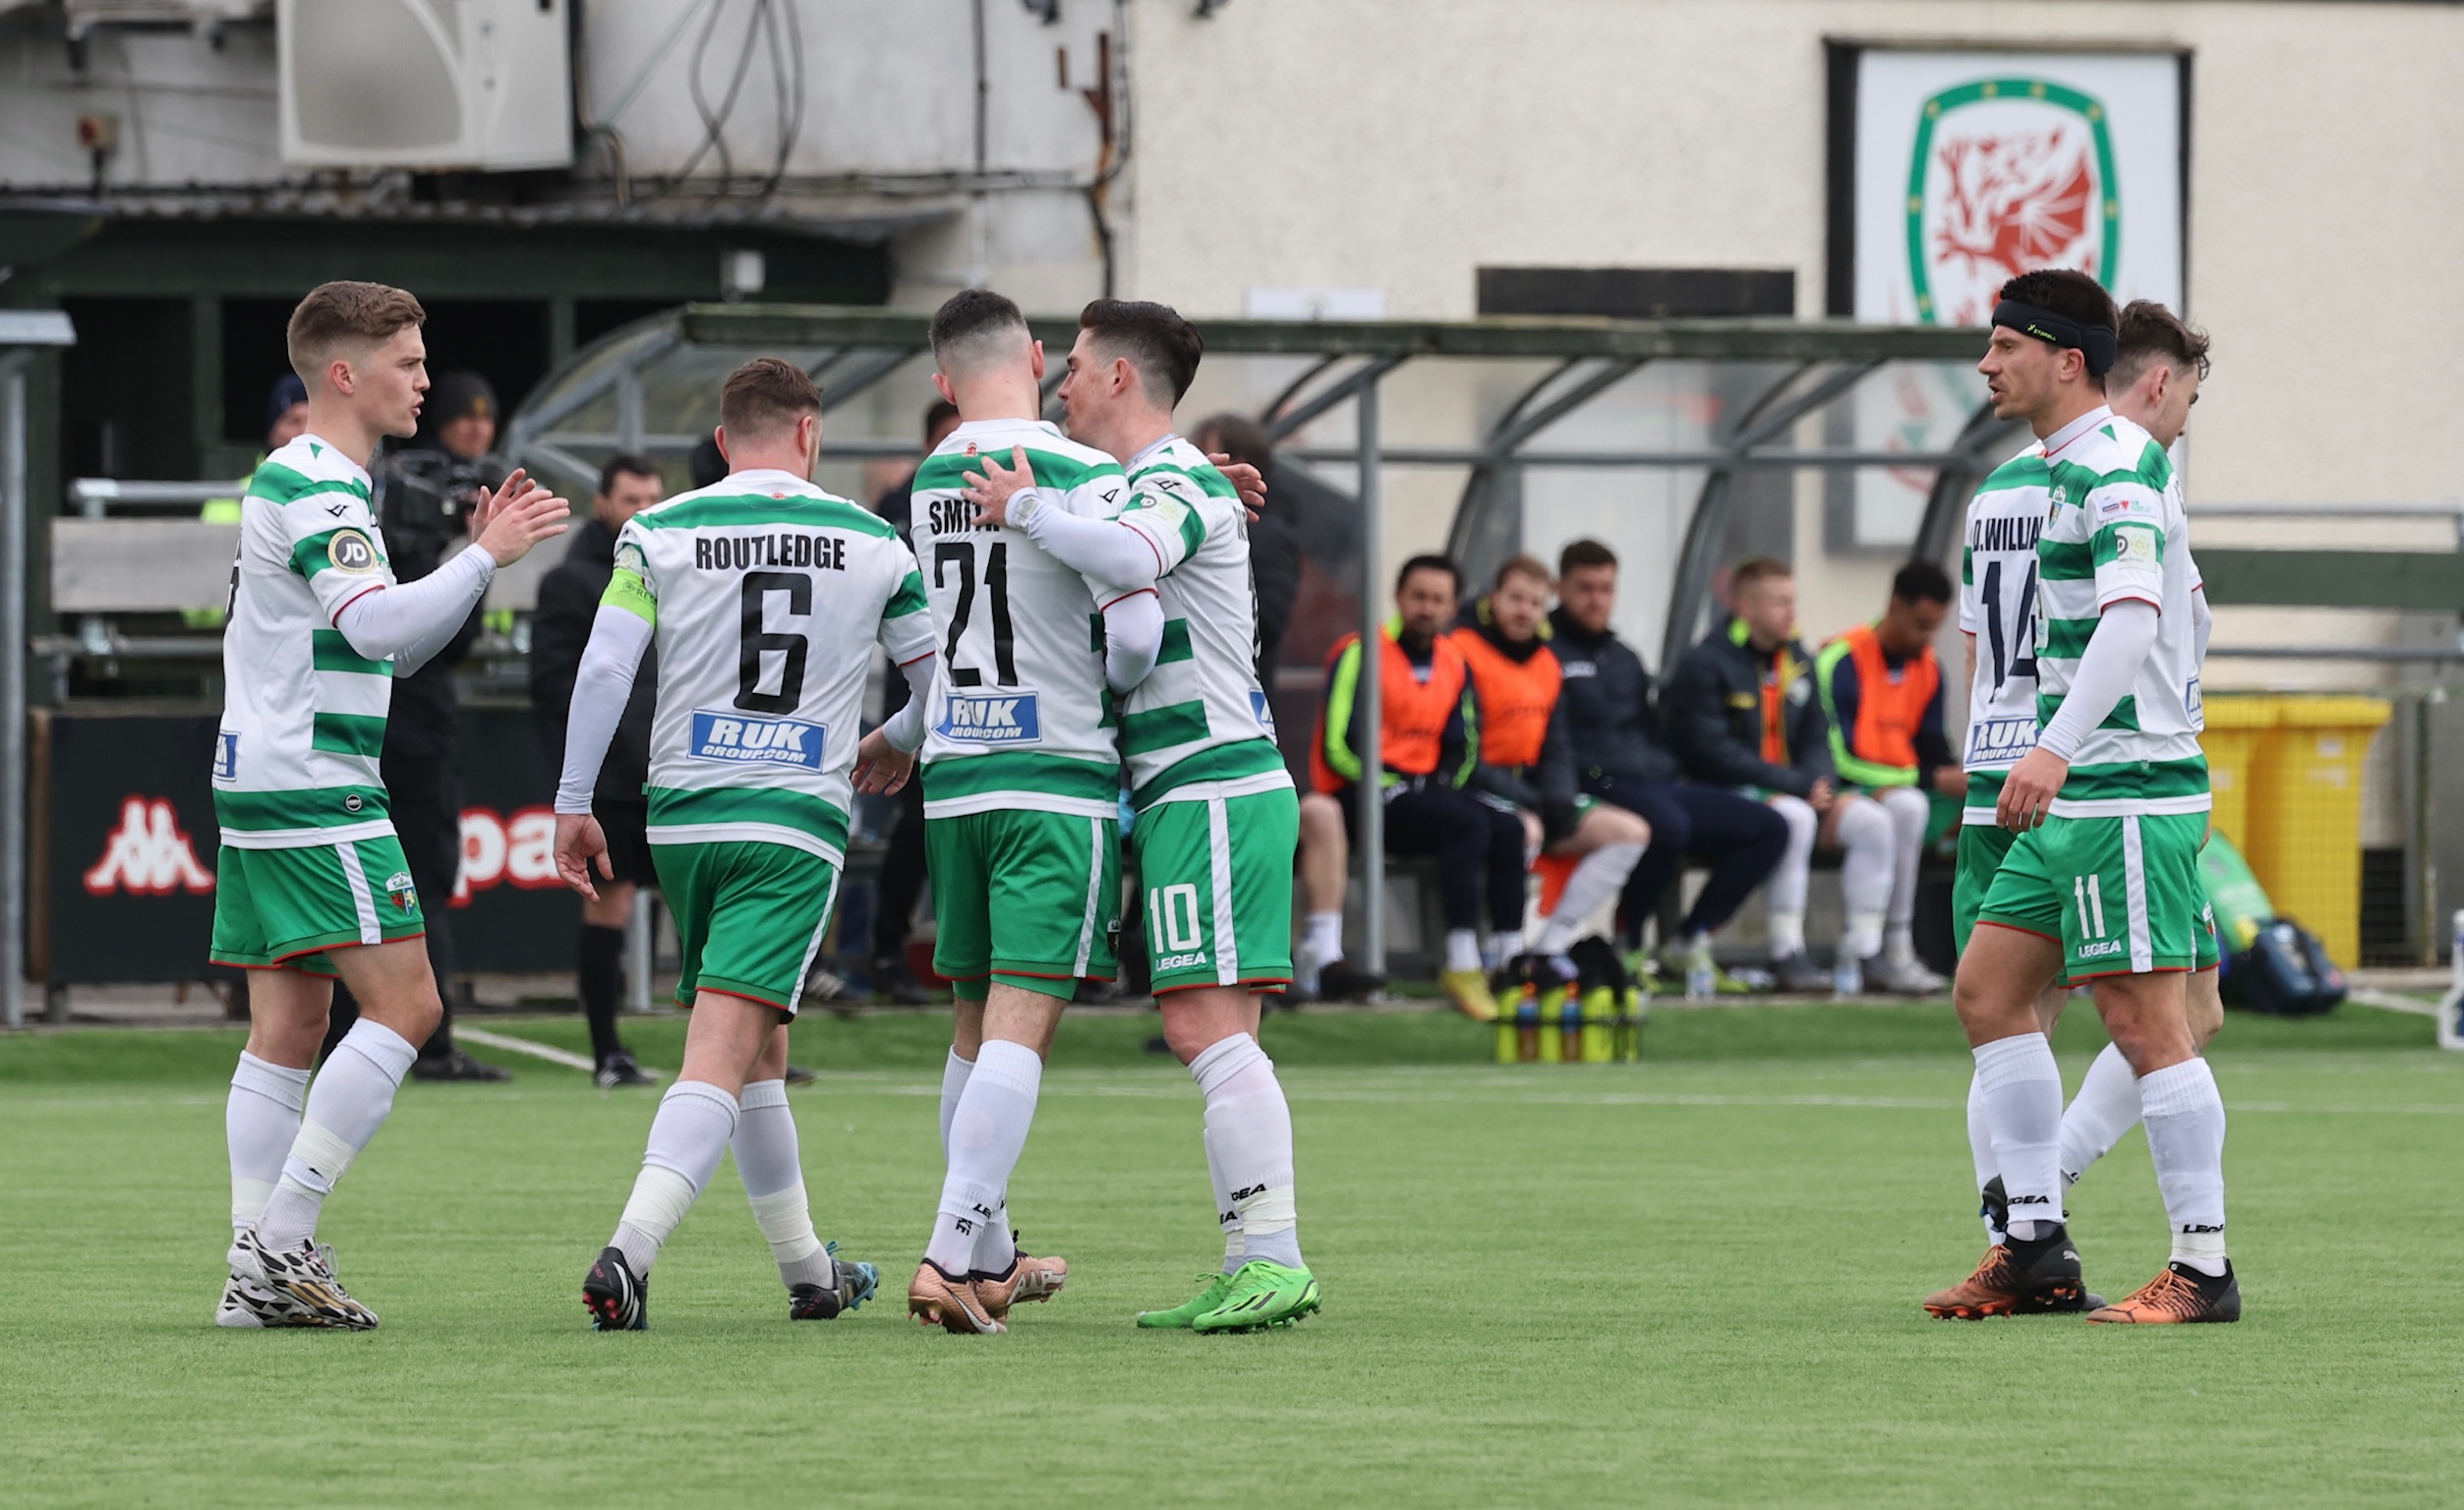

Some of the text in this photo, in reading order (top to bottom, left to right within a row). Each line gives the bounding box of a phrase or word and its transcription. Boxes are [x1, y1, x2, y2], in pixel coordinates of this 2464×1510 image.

[341, 543, 368, 564] JD
[694, 533, 846, 571] ROUTLEDGE
[934, 542, 1019, 686] 21
[733, 572, 812, 715] 6
[1982, 559, 2039, 704] 14
[951, 699, 1020, 727] RUK
[708, 719, 810, 751] RUK
[1974, 720, 2038, 751] RUK
[701, 744, 807, 763] GROUP.COM
[1149, 883, 1203, 954] 10
[2075, 873, 2106, 940] 11
[1156, 952, 1206, 972] LEGEA
[2078, 939, 2122, 958] LEGEA
